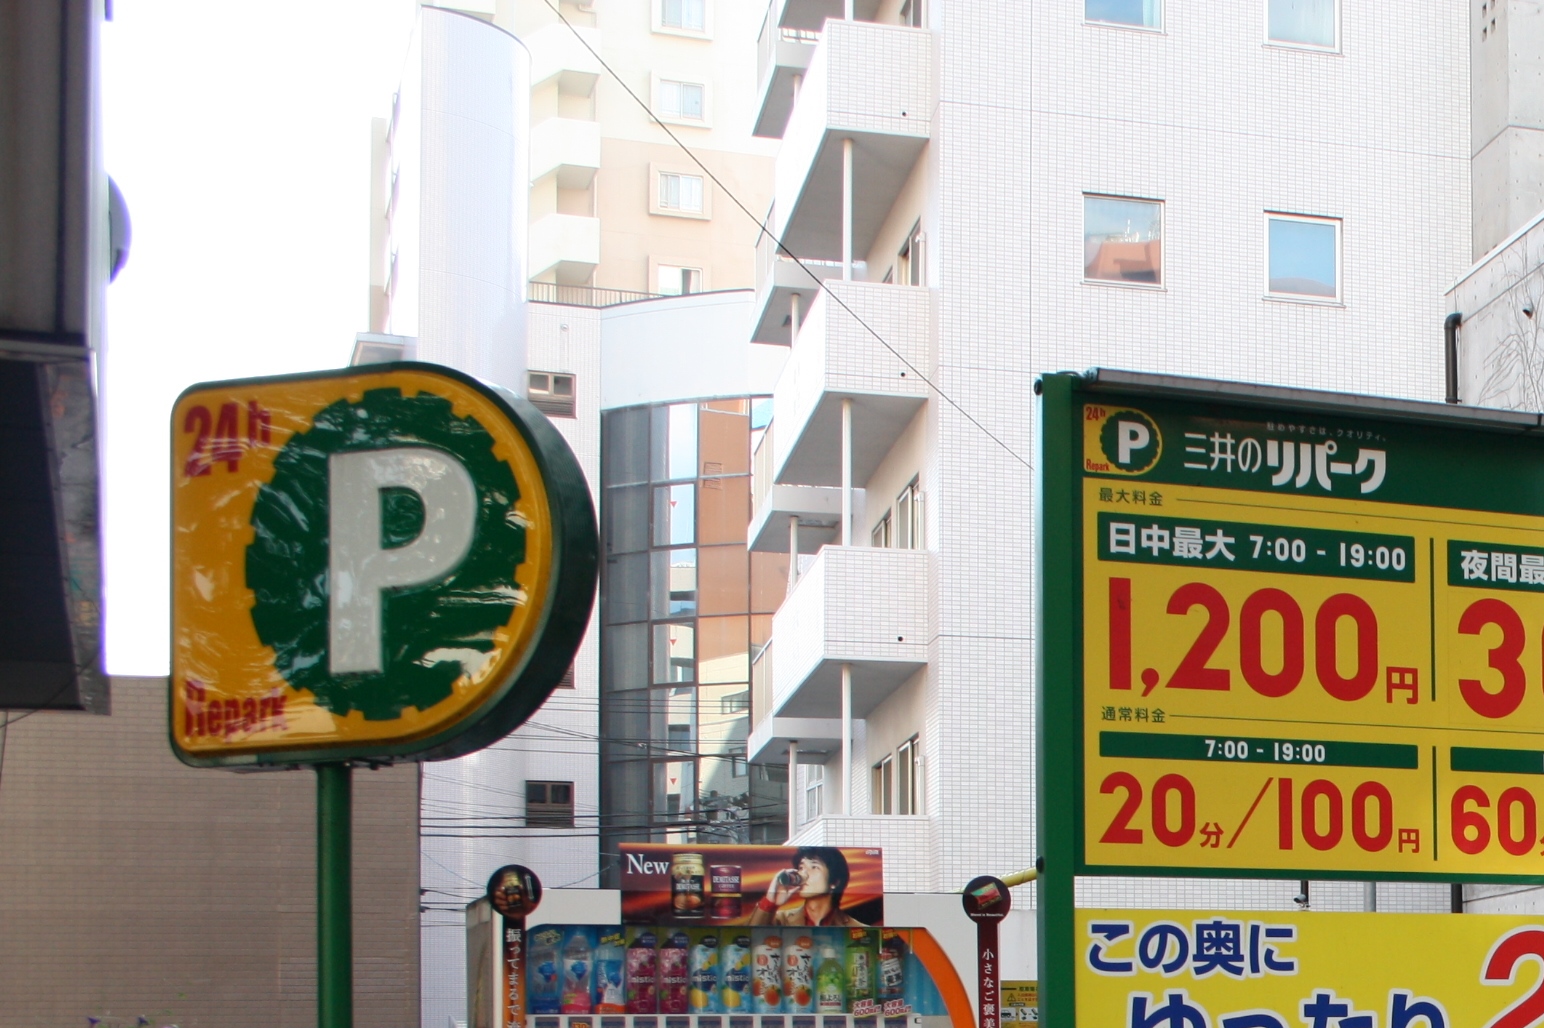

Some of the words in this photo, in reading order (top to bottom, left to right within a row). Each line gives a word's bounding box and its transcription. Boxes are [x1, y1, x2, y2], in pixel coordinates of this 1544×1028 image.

[1086, 458, 1110, 472] Repark
[1184, 432, 1386, 494] 三井のリパーク
[1099, 486, 1163, 507] 最大料金
[329, 447, 477, 675] P
[1109, 521, 1236, 562] 日中最大
[1249, 535, 1306, 563] 7:00
[1340, 542, 1406, 571] 19:00
[1109, 576, 1419, 705] 1,200円
[184, 680, 288, 743] Repark
[1101, 706, 1166, 723] 通常料金
[1204, 739, 1249, 759] 7:00
[1273, 742, 1326, 763] 19:00
[626, 853, 669, 875] New
[1088, 920, 1296, 976] この奥に
